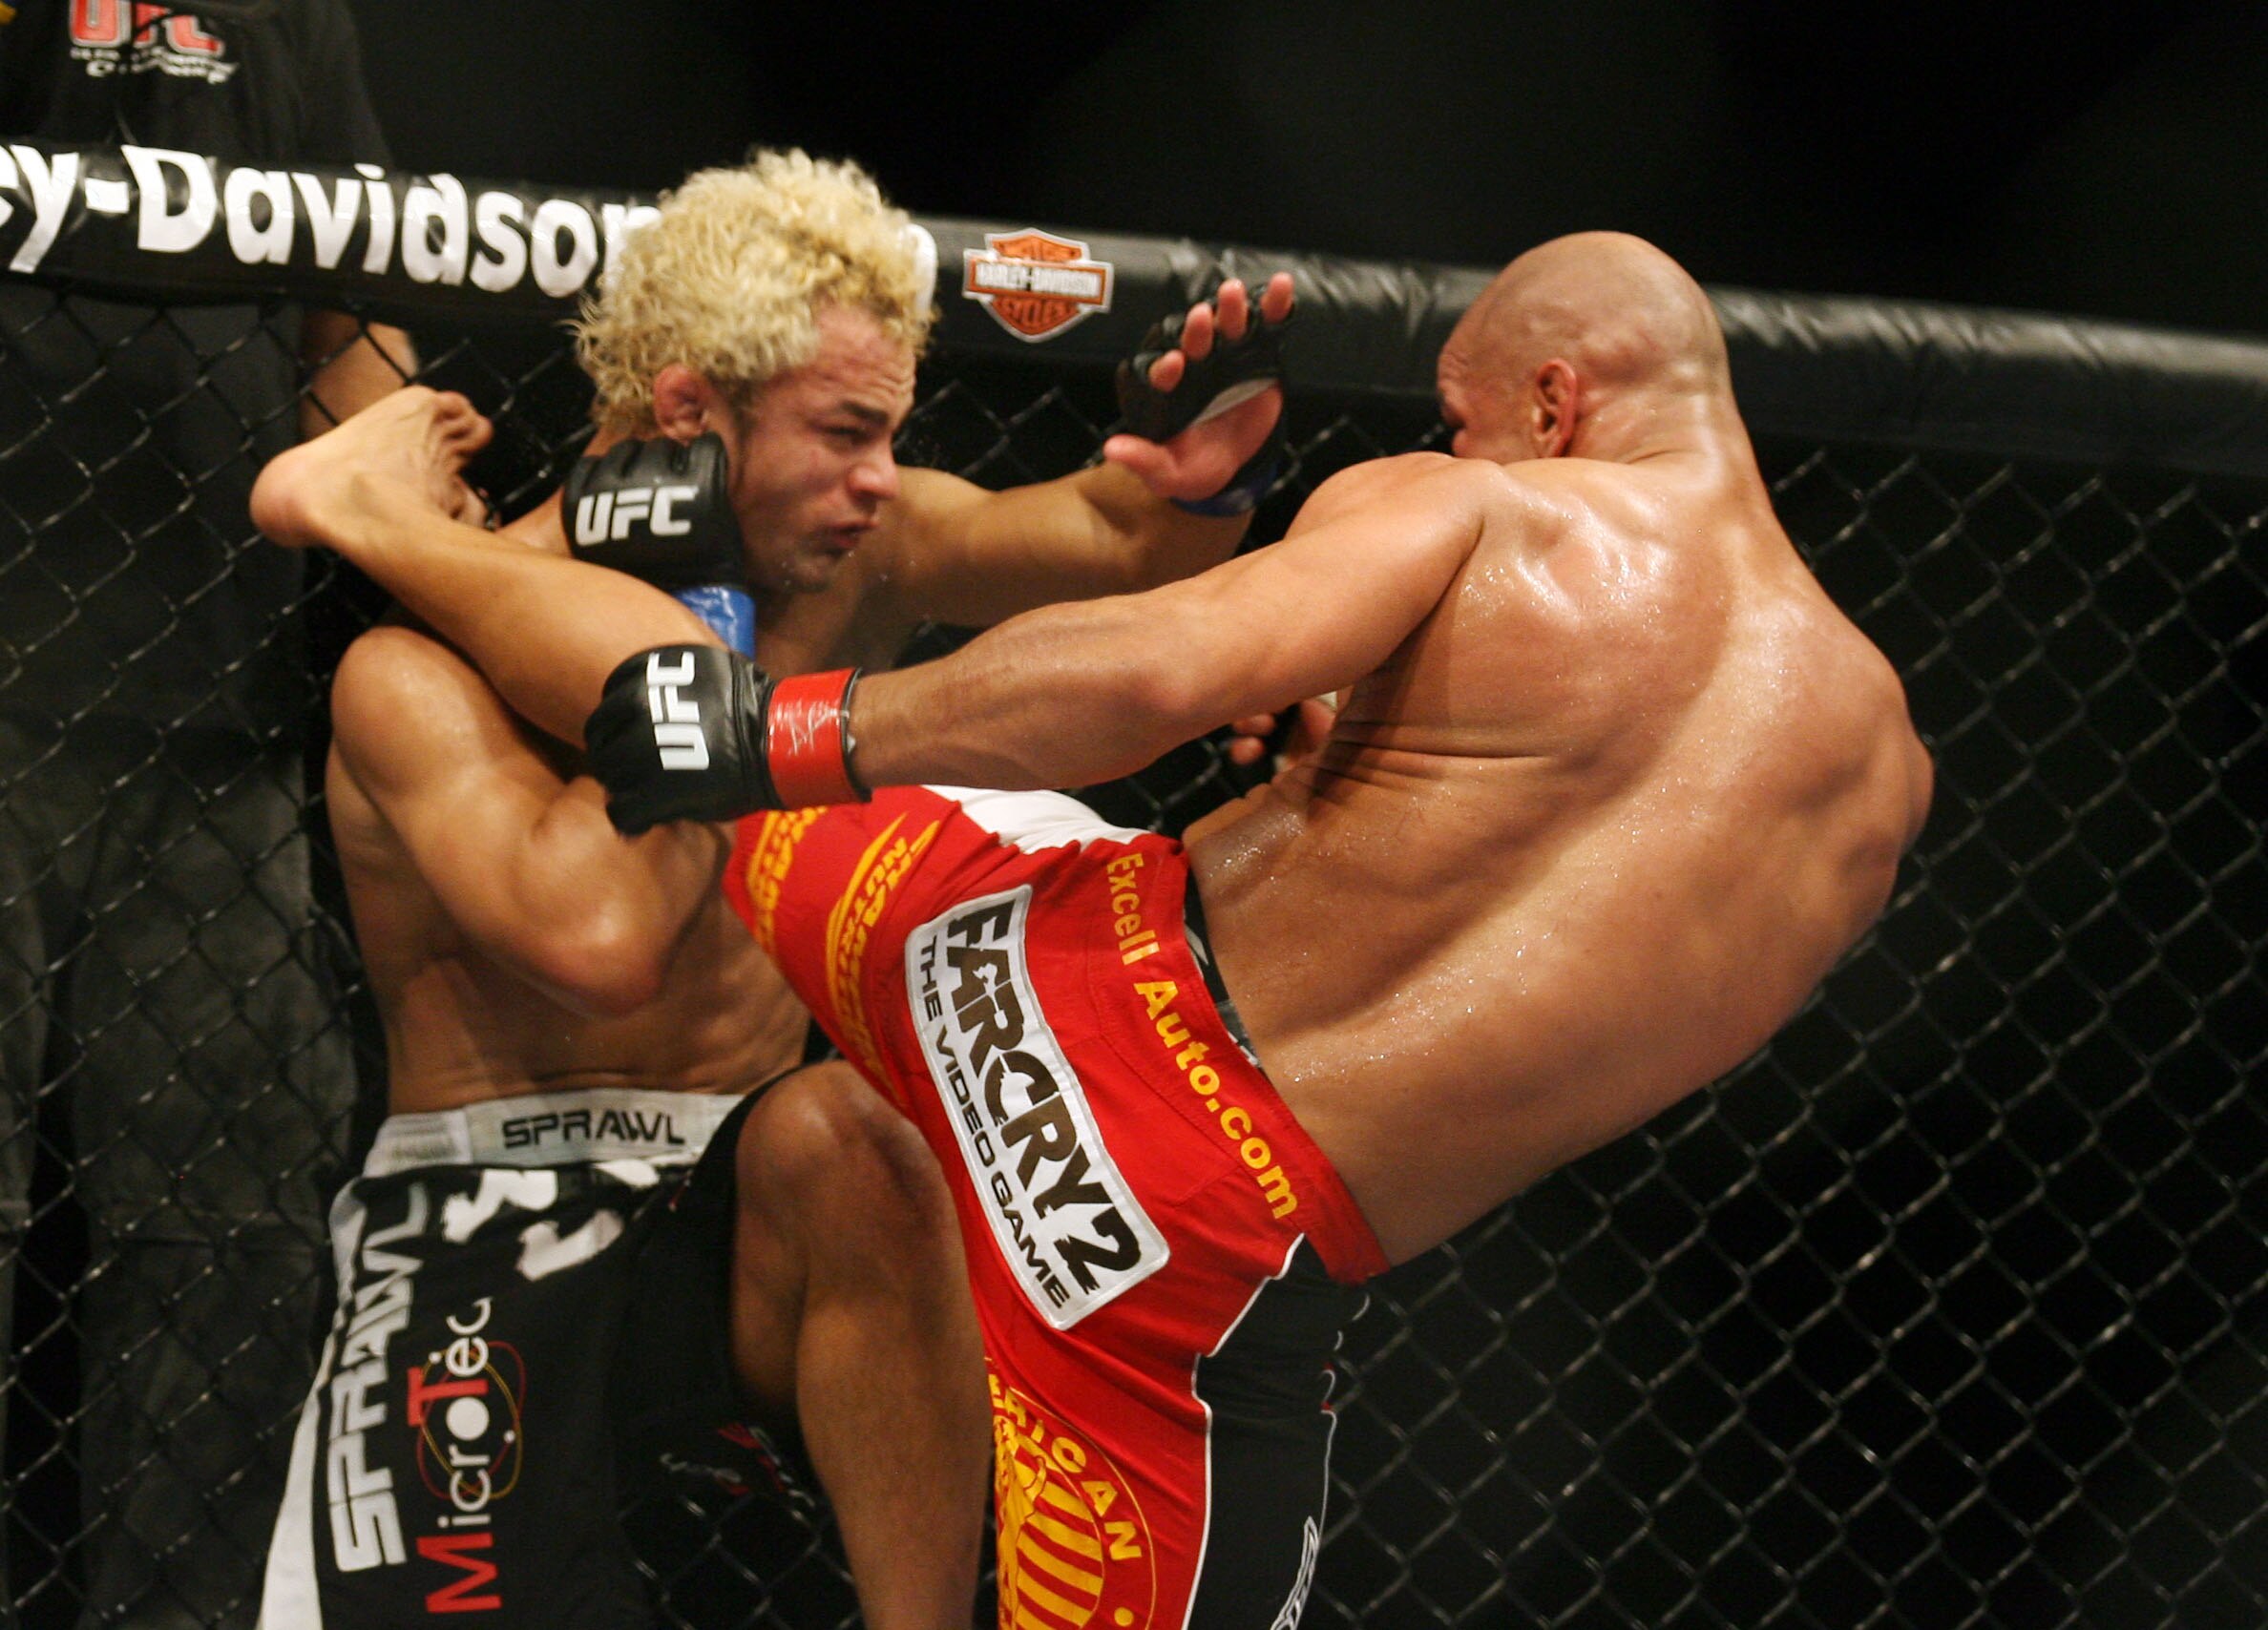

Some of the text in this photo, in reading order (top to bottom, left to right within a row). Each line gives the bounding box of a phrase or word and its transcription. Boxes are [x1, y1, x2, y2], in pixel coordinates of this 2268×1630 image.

[576, 485, 699, 547] UFC
[646, 651, 709, 770] UFC
[502, 1108, 685, 1147] SPRAWL
[920, 934, 1070, 1309] THE VIDEO GAME
[1105, 852, 1298, 1220] Excell Auto.com
[326, 1181, 429, 1572] SPRAWL
